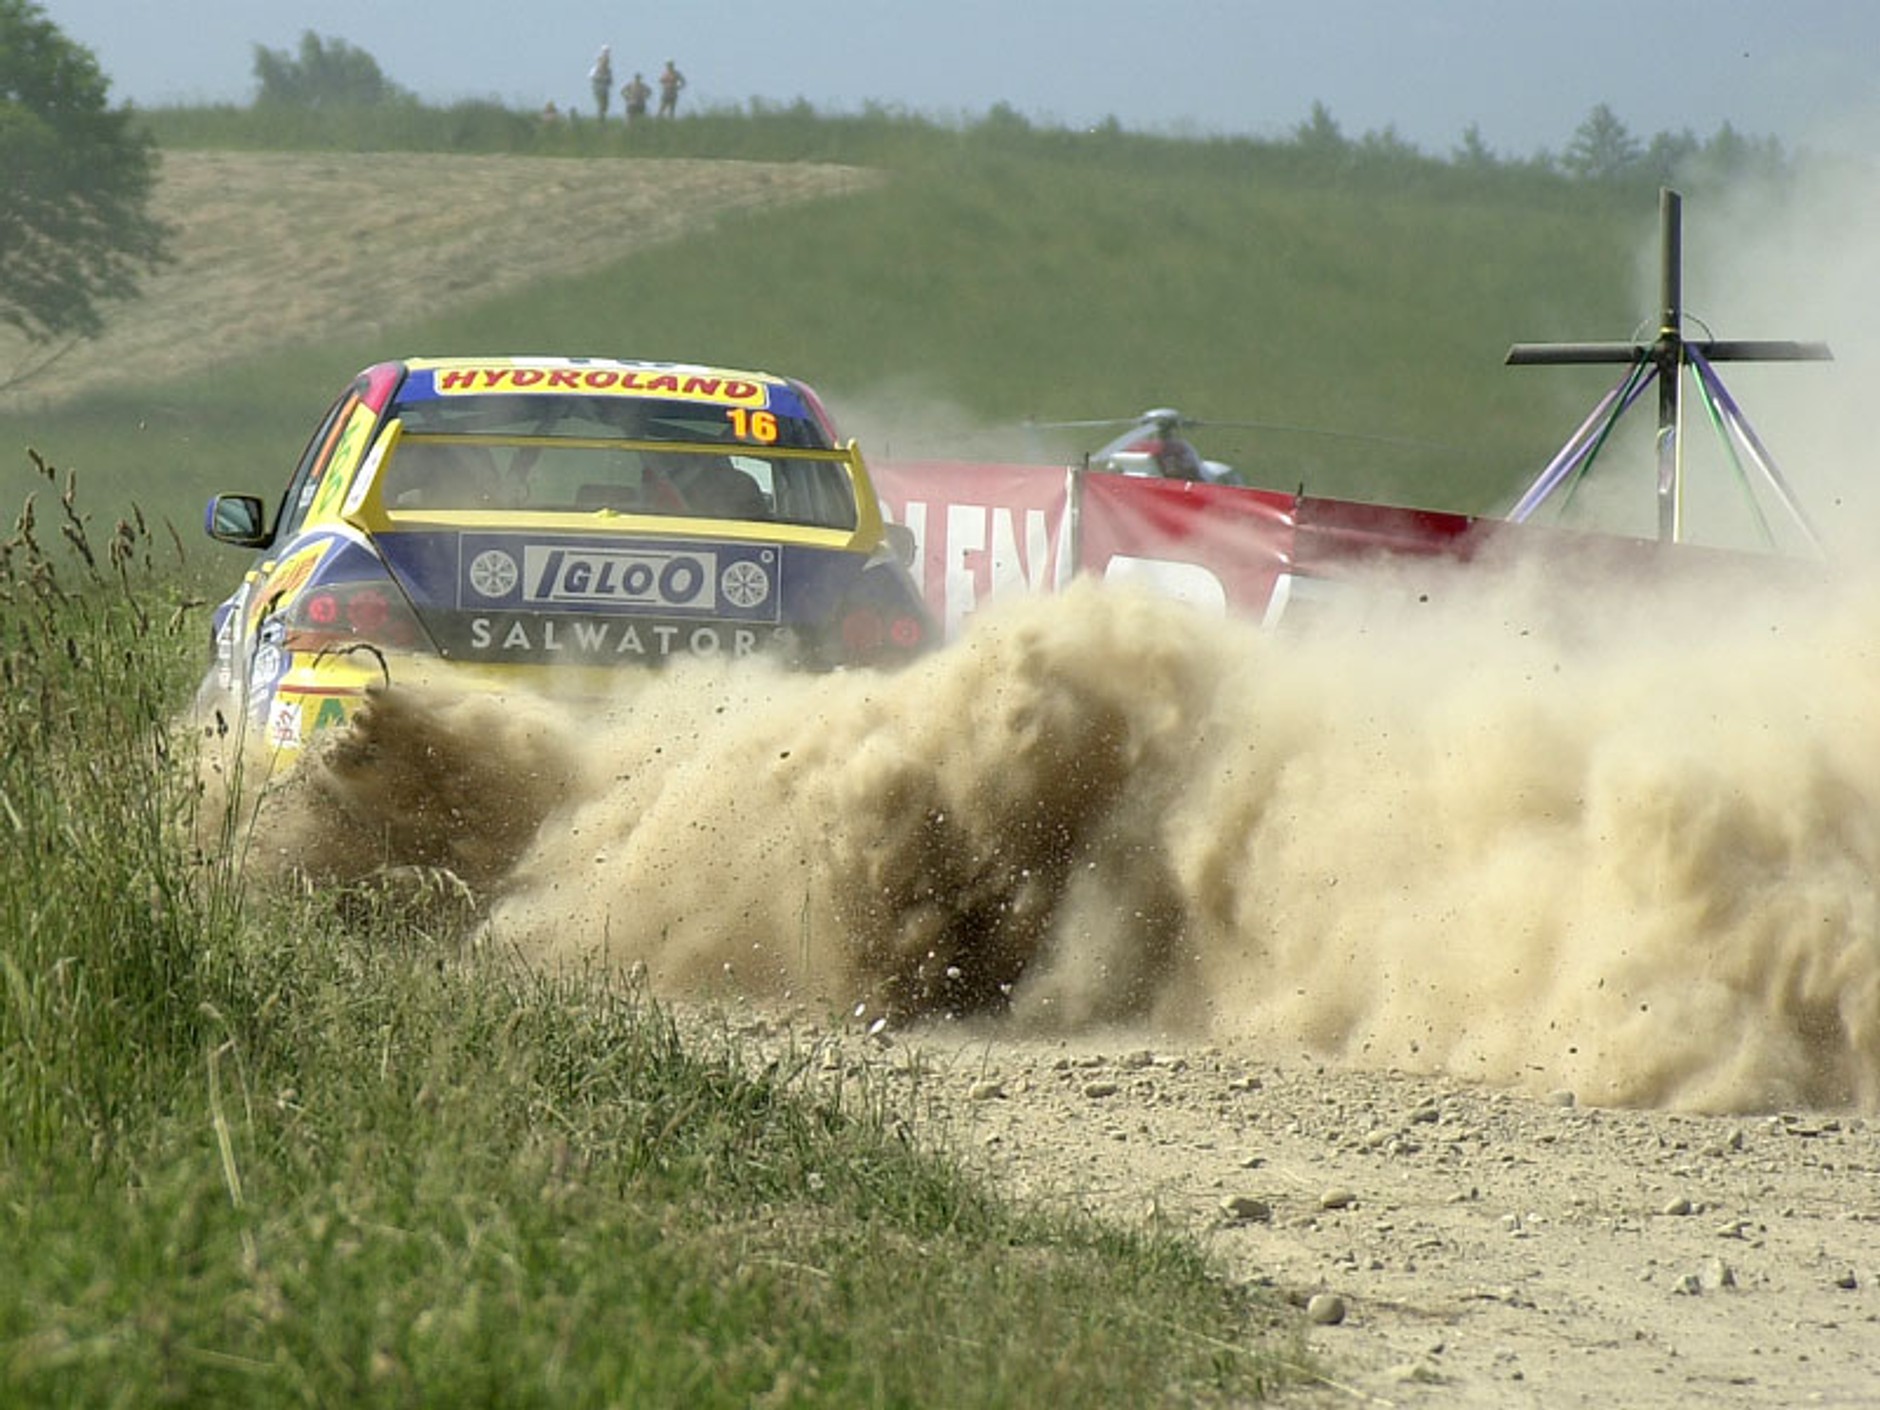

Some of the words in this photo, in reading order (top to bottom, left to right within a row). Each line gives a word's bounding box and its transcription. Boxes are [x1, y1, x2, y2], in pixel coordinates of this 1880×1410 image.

[442, 368, 758, 399] HYDROLAND
[727, 408, 778, 443] 16
[536, 551, 704, 604] IGLOO
